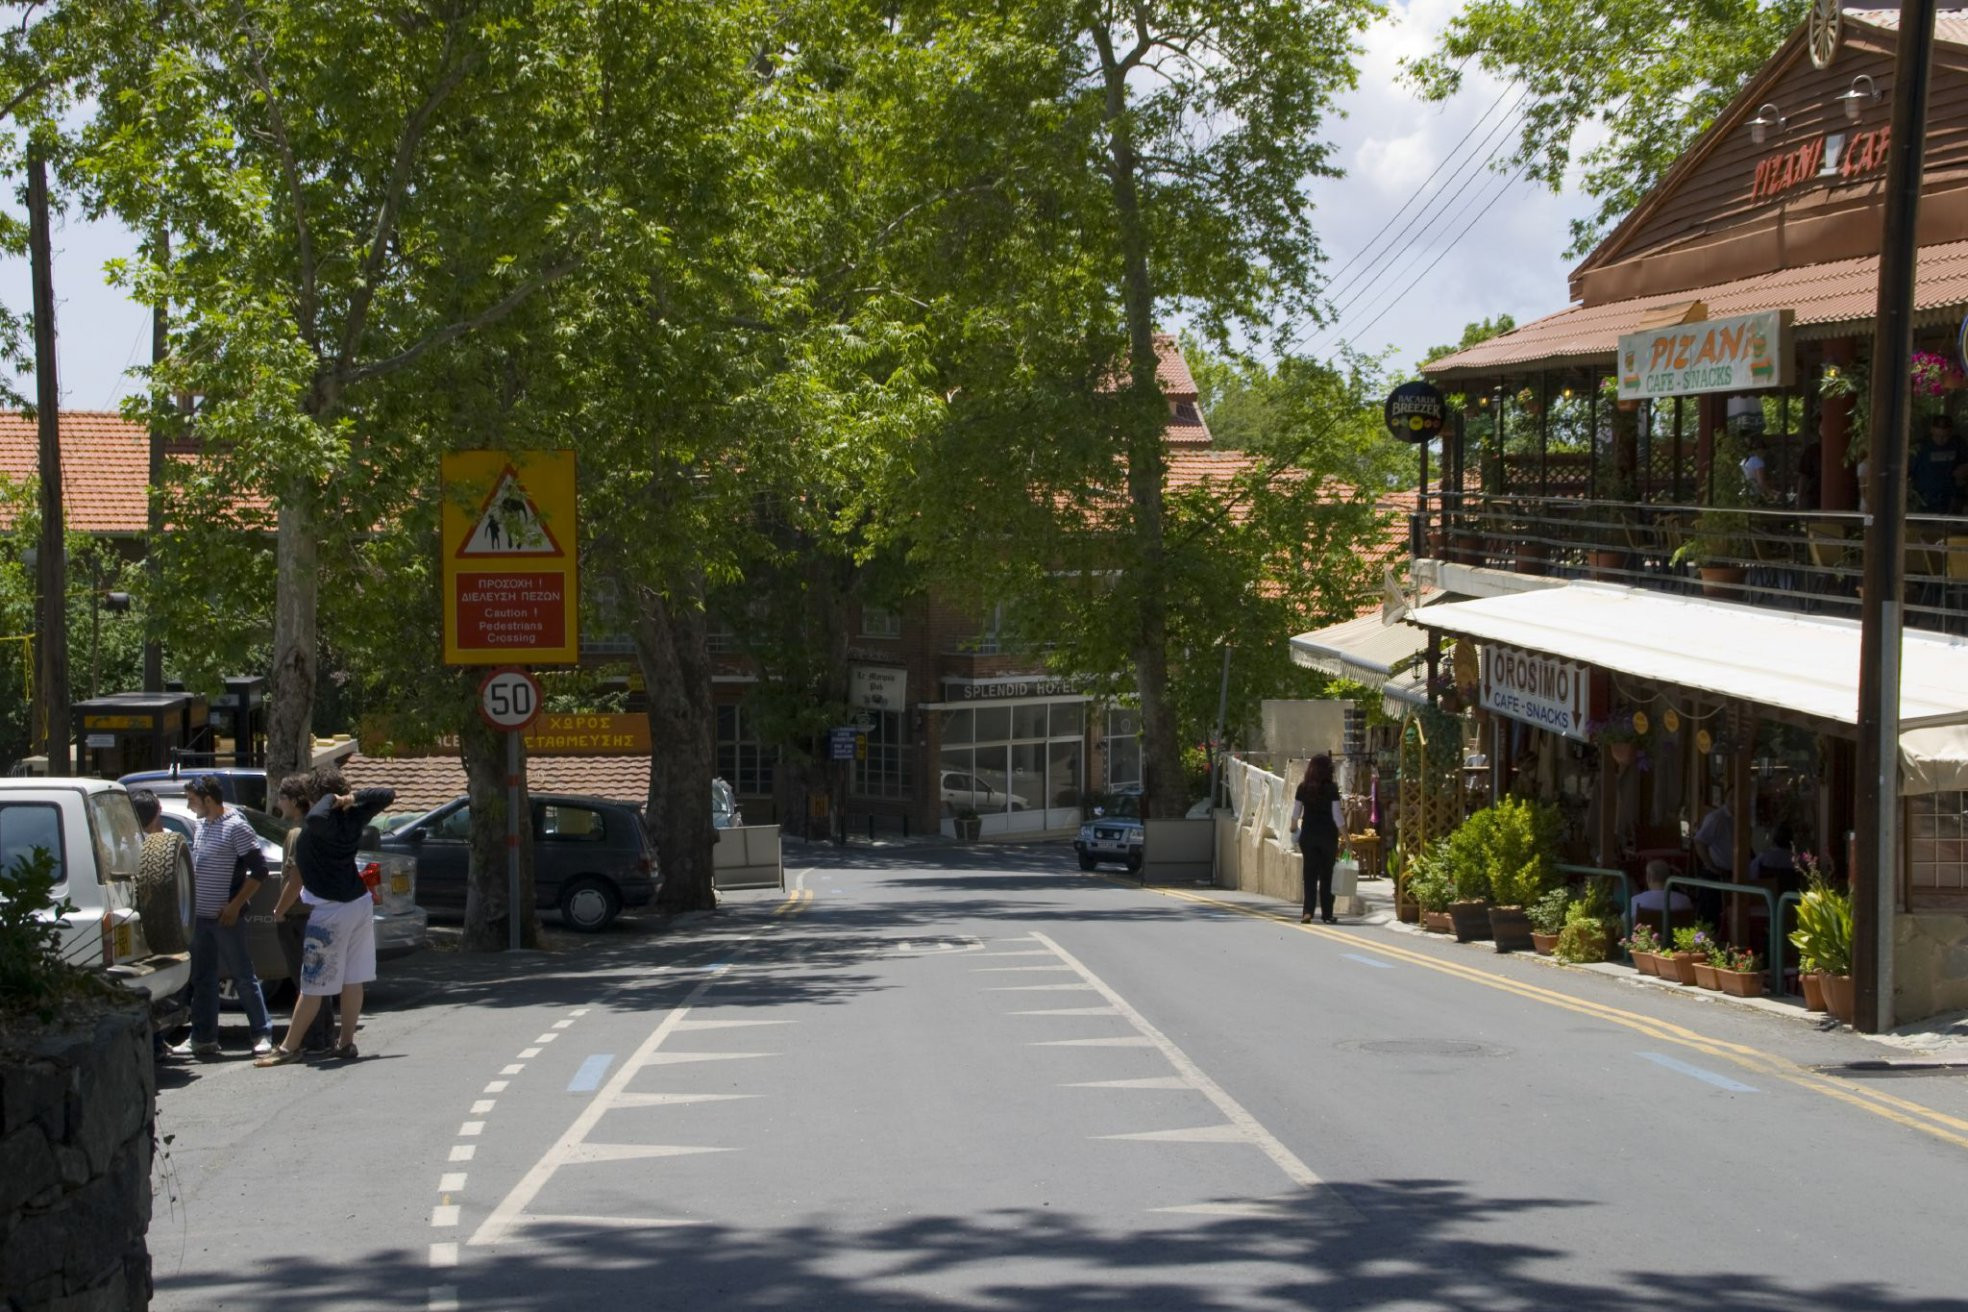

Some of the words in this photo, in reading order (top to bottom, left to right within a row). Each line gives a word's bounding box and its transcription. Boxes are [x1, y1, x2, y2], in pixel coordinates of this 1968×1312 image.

[1751, 136, 1825, 202] PIZANI
[1840, 125, 1891, 177] CAF
[1646, 372, 1675, 393] CAFE
[1683, 365, 1732, 389] SNACKS
[1391, 402, 1441, 417] BREEZER
[478, 579, 533, 589] ΠΡΟΣΟΧΗ
[461, 592, 517, 602] ΔΙΕΛΕΥΣΗ
[484, 608, 528, 618] Caution
[479, 621, 543, 631] Pedestrians
[487, 633, 536, 644] Crossing
[1494, 652, 1569, 704] OROSIMO
[963, 682, 1028, 698] SPLENDID
[1036, 679, 1078, 694] HOTEL
[491, 683, 531, 715] 50
[551, 717, 611, 730] ΧΩΡΟΣ
